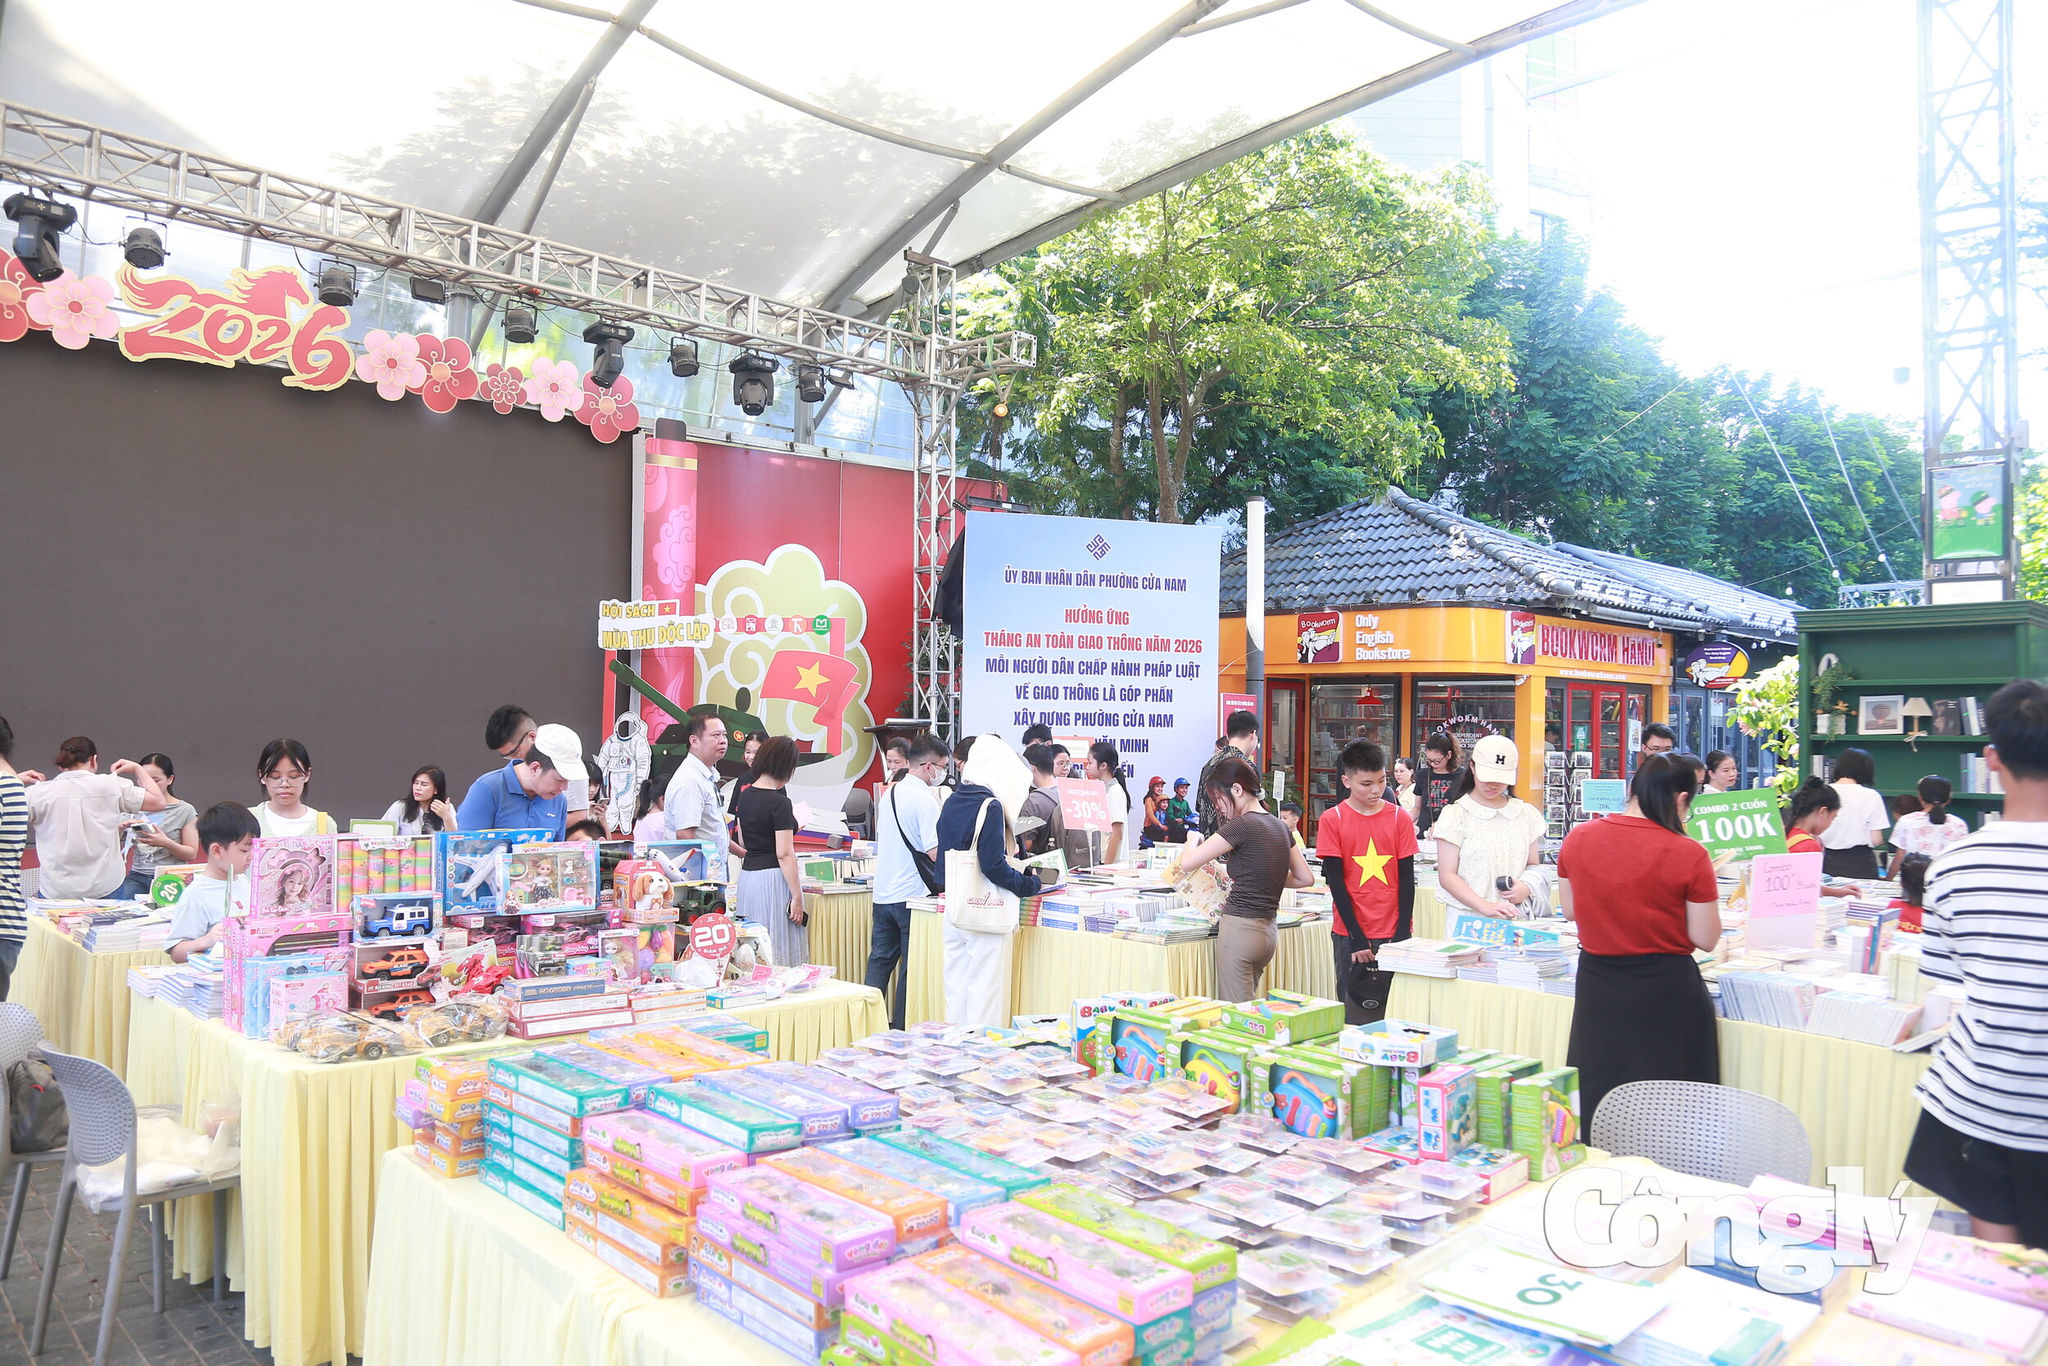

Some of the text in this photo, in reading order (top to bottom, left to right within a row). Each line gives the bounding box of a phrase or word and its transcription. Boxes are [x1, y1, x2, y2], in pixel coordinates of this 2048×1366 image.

[120, 303, 354, 391] 2026
[1005, 566, 1187, 592] ỦY BAN NHÂN DÂN PHƯỜNG CỬA NAM
[602, 601, 655, 619] HỘI SÁCH
[1065, 604, 1130, 625] HƯỞNG ỨNG
[1300, 617, 1336, 628] Bookworm
[1356, 614, 1379, 629] Only
[602, 620, 711, 650] MÙA THU ĐỘC LẬP
[984, 629, 1203, 653] THÁNG AN TOÀN GIAO THÔNG NĂM 2026
[1356, 631, 1394, 646] English
[1539, 624, 1655, 667] BOOKWORM HANOI
[1356, 648, 1411, 661] Bookstore
[985, 653, 1200, 681] MỖI NGƯỜI DÂN CHẤP HÀNH PHÁP LUẬT
[1015, 681, 1173, 703] VỀ GIAO THÔNG LÀ GÓP PHẦN
[1013, 707, 1174, 728] XÂY DỰNG PHƯỜNG CỬA NAM
[1120, 739, 1149, 753] MINH
[1066, 799, 1106, 820] -30%
[1694, 798, 1767, 815] COMBO 2 CUỐN
[1695, 812, 1778, 844] 100K
[1080, 1005, 1116, 1018] BABY
